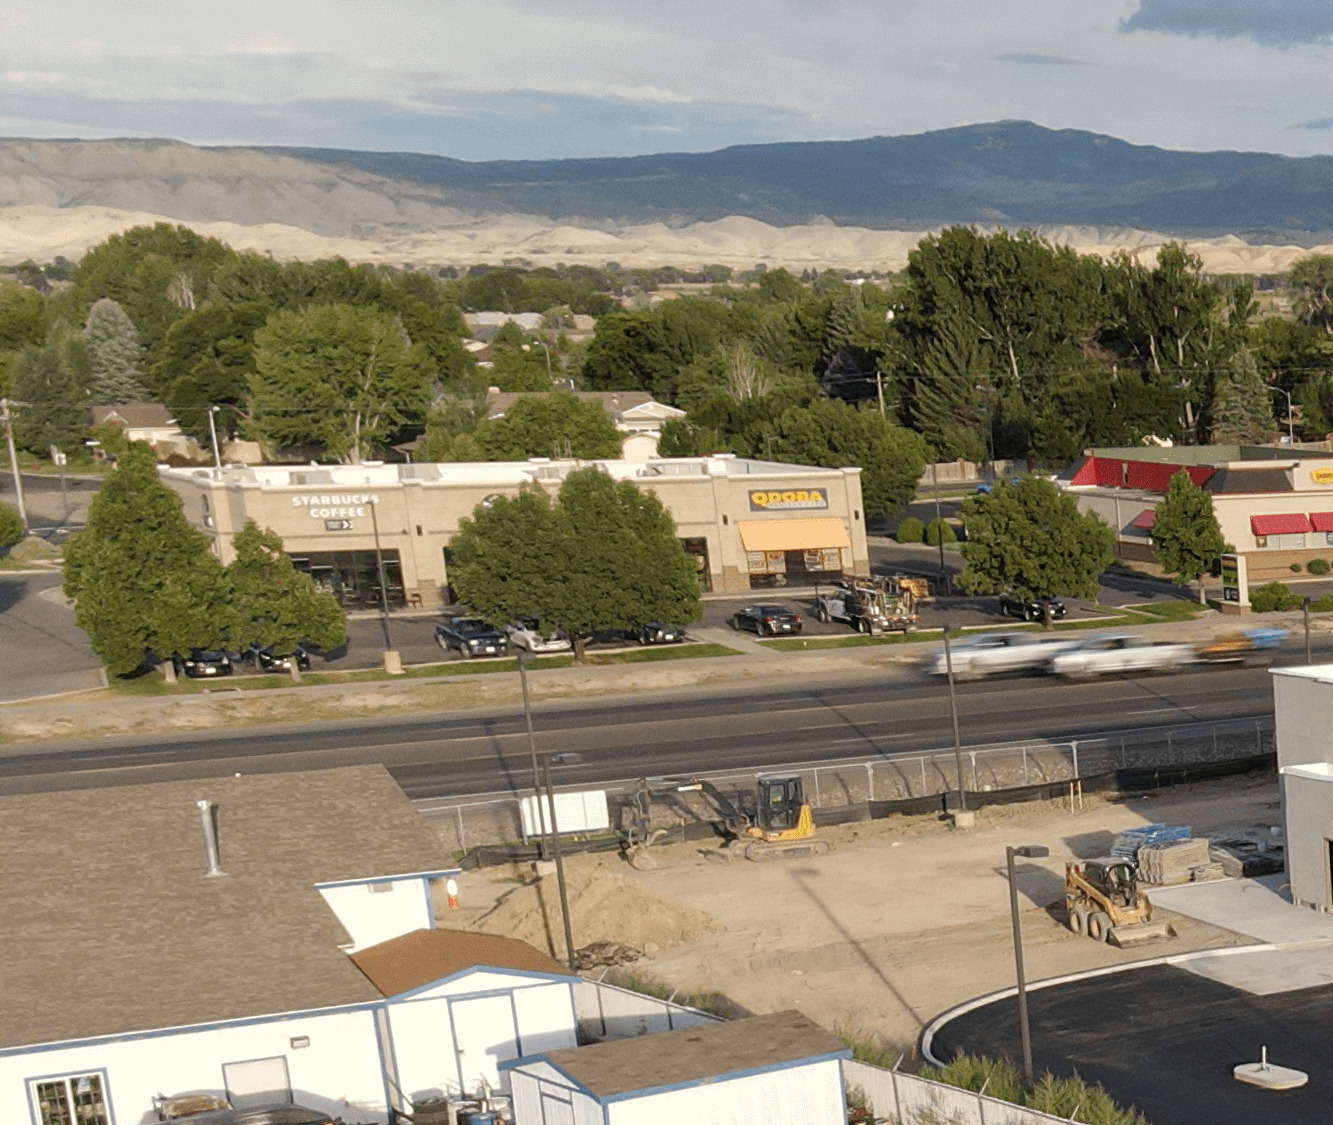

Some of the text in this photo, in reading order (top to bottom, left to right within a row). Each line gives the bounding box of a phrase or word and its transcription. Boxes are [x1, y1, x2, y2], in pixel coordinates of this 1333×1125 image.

[292, 493, 380, 507] STARBUCKS
[751, 490, 824, 507] QDOBA
[310, 507, 366, 518] COFFEE
